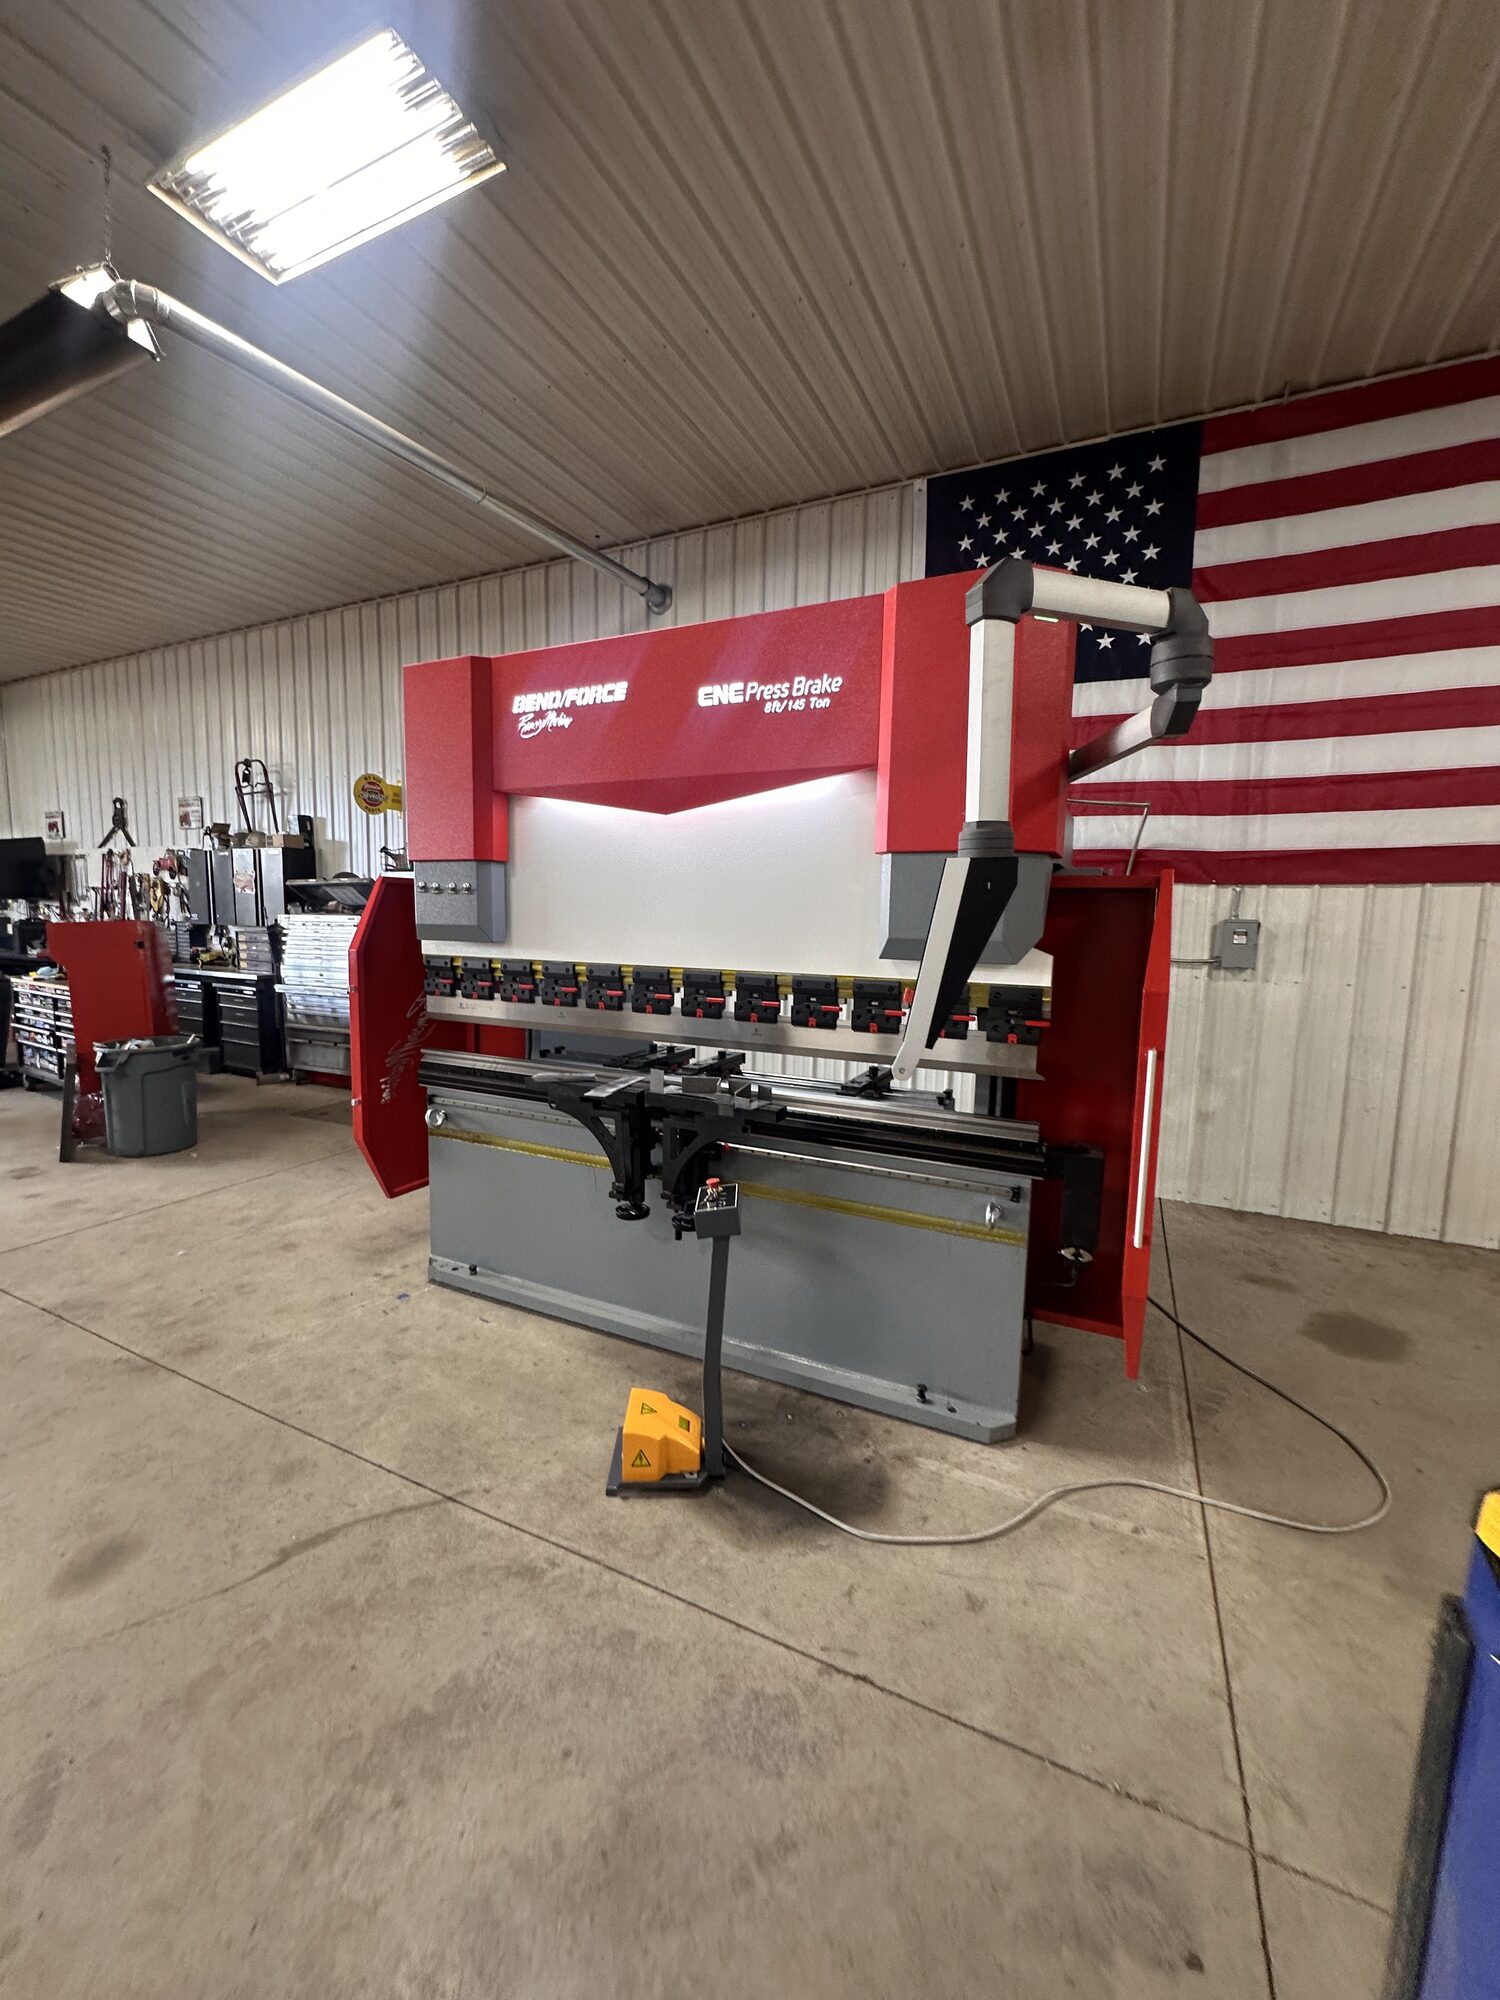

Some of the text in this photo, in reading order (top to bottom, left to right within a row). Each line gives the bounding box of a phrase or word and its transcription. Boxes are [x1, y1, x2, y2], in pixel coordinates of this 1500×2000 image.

[511, 681, 629, 714] BEND/FORCE
[744, 681, 791, 702] Press
[792, 673, 843, 697] Brake
[809, 696, 831, 709] Ton
